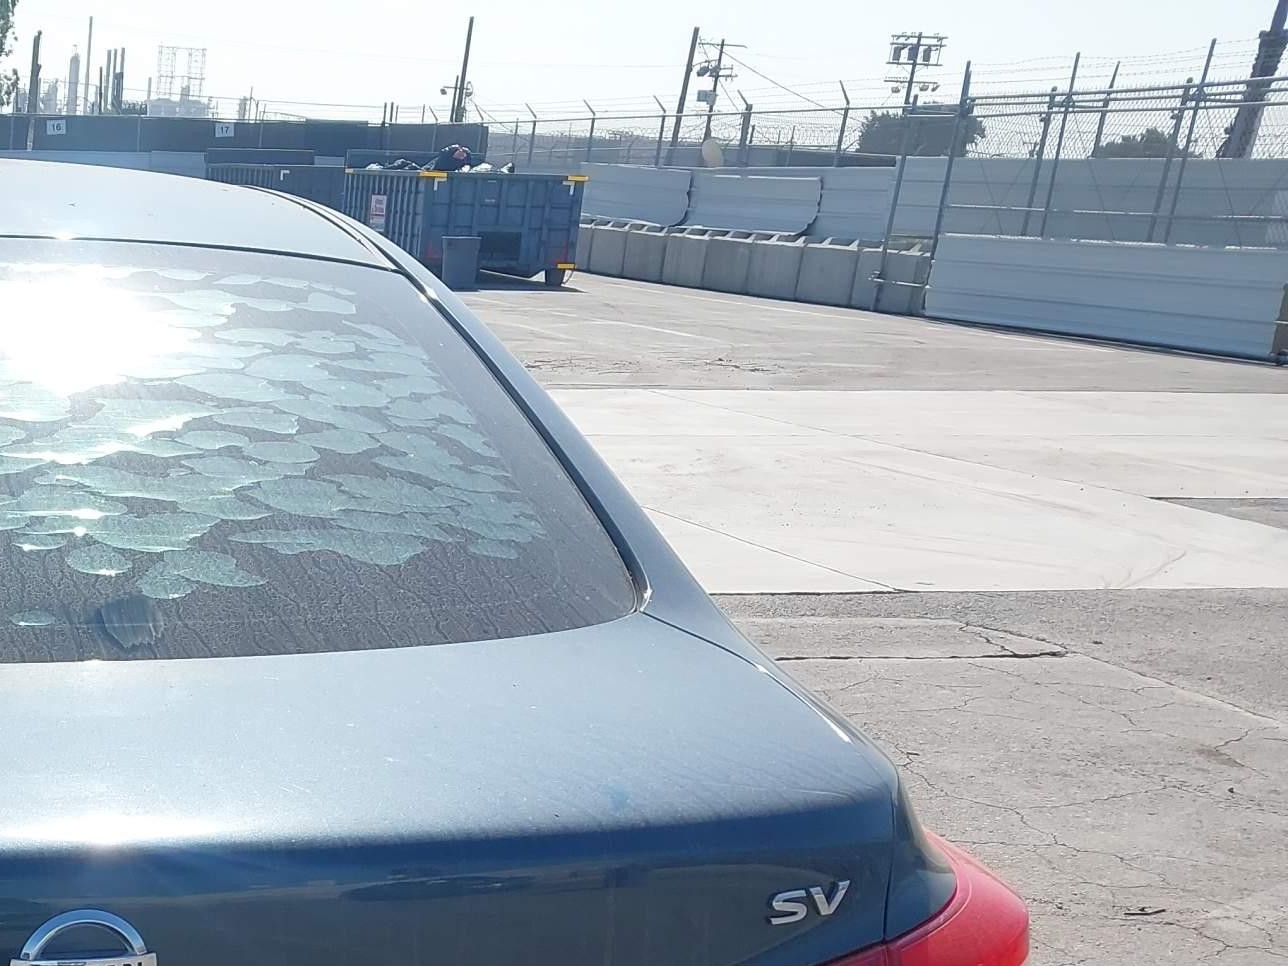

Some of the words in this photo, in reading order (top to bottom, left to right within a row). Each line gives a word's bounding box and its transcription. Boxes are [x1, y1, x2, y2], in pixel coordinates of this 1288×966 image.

[52, 123, 62, 132] 16
[220, 126, 230, 135] 17
[770, 880, 851, 925] SV
